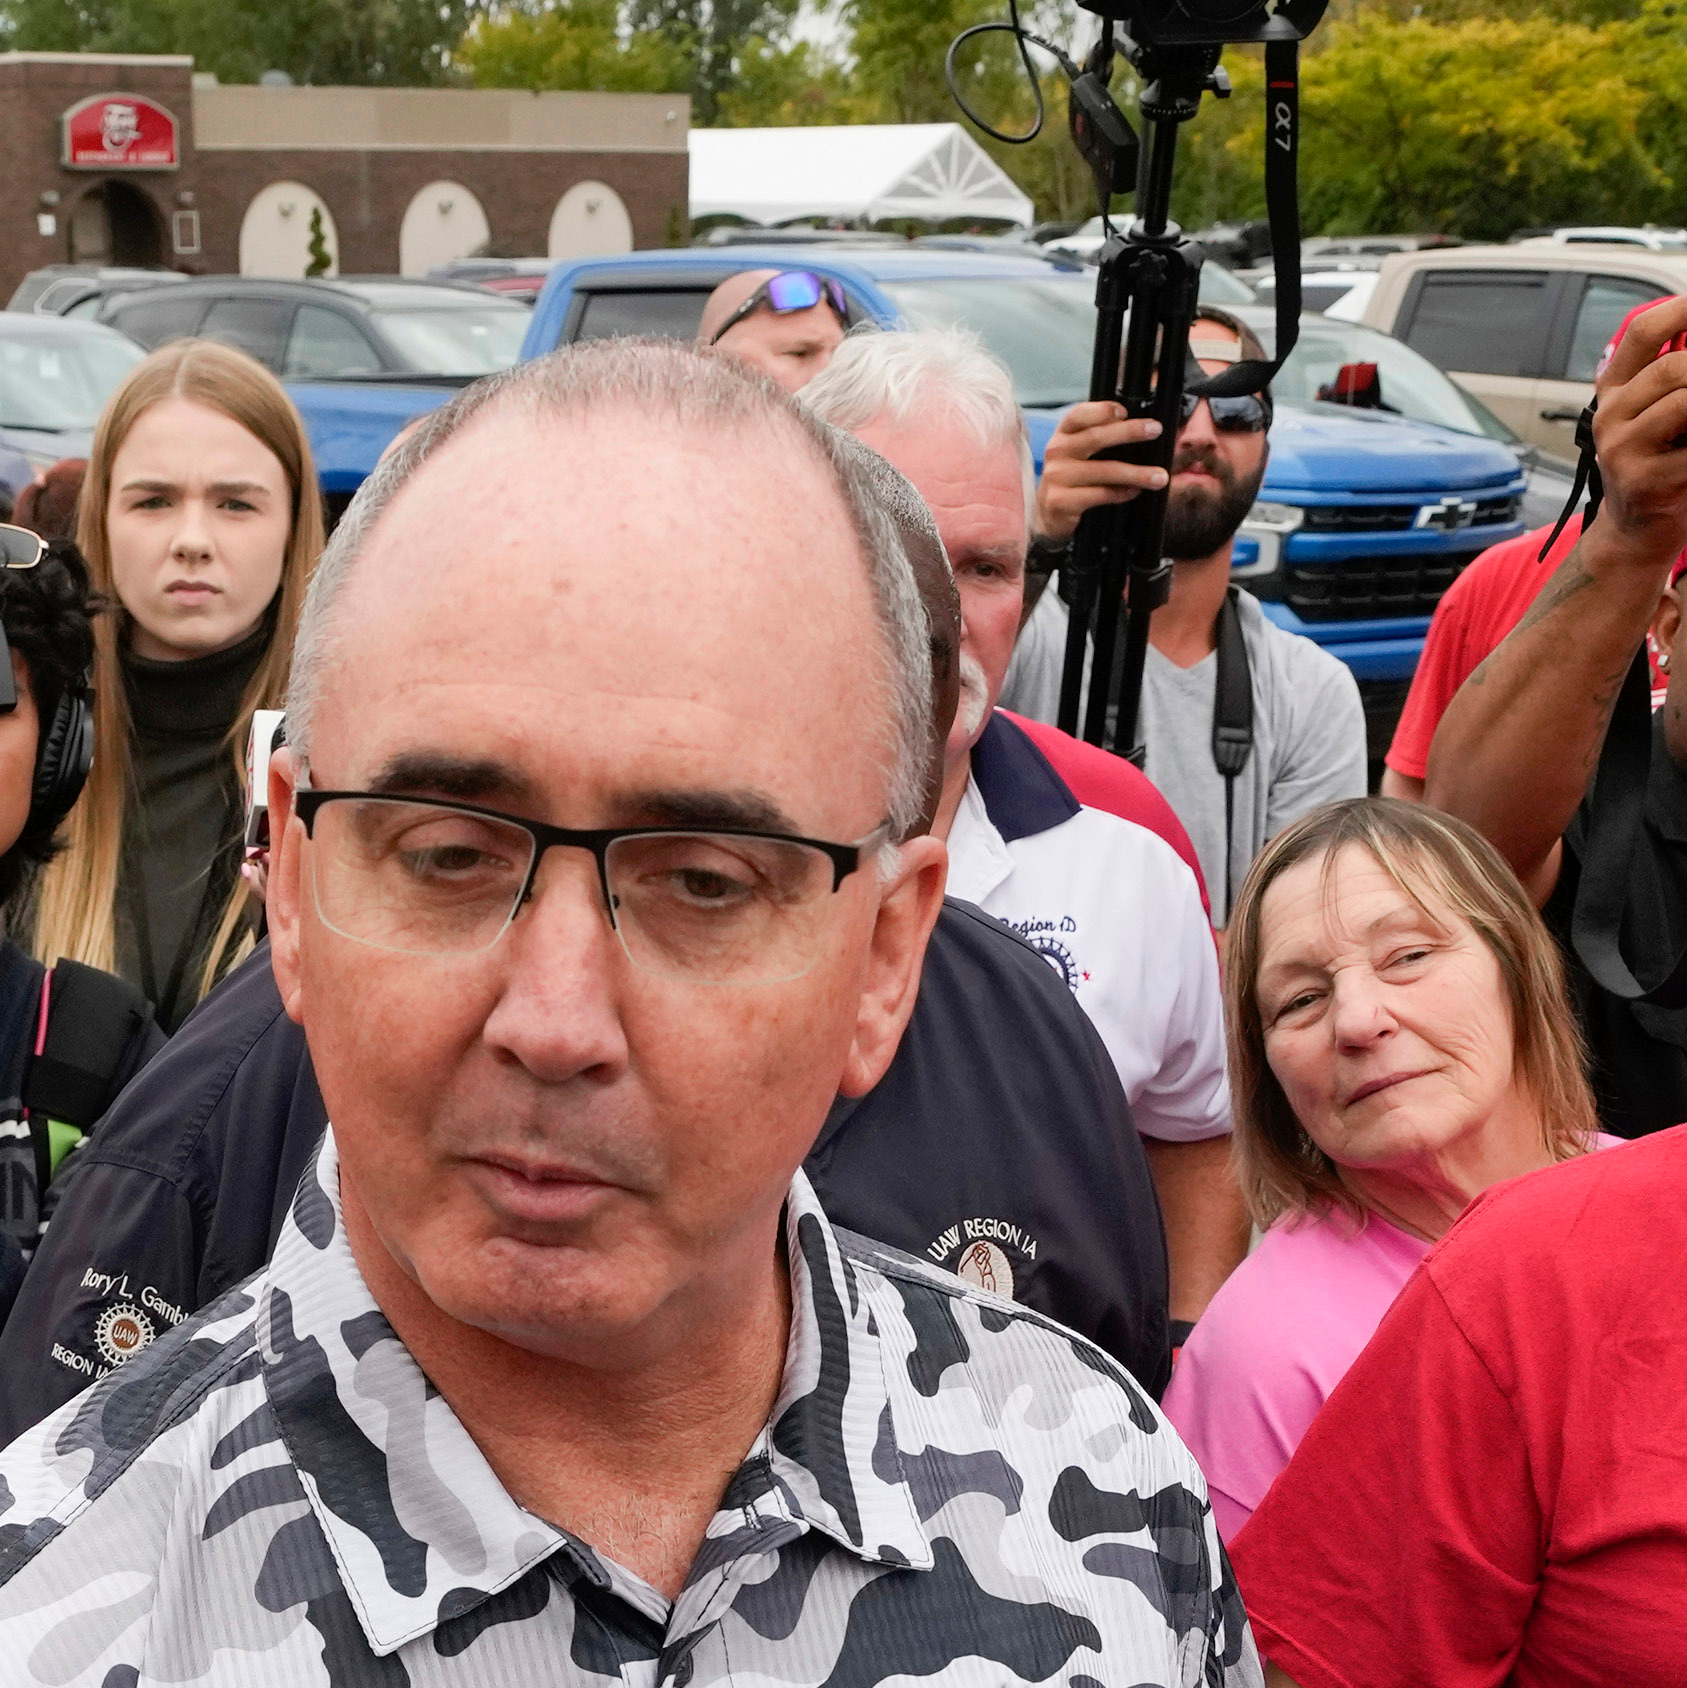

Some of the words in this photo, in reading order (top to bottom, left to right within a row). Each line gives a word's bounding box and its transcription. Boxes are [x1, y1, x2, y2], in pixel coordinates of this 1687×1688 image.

[926, 1224, 961, 1261] UAW
[963, 1217, 1022, 1247] REGION
[80, 1267, 126, 1296] Rory
[113, 1325, 138, 1346] UAW
[51, 1342, 95, 1376] REGION
